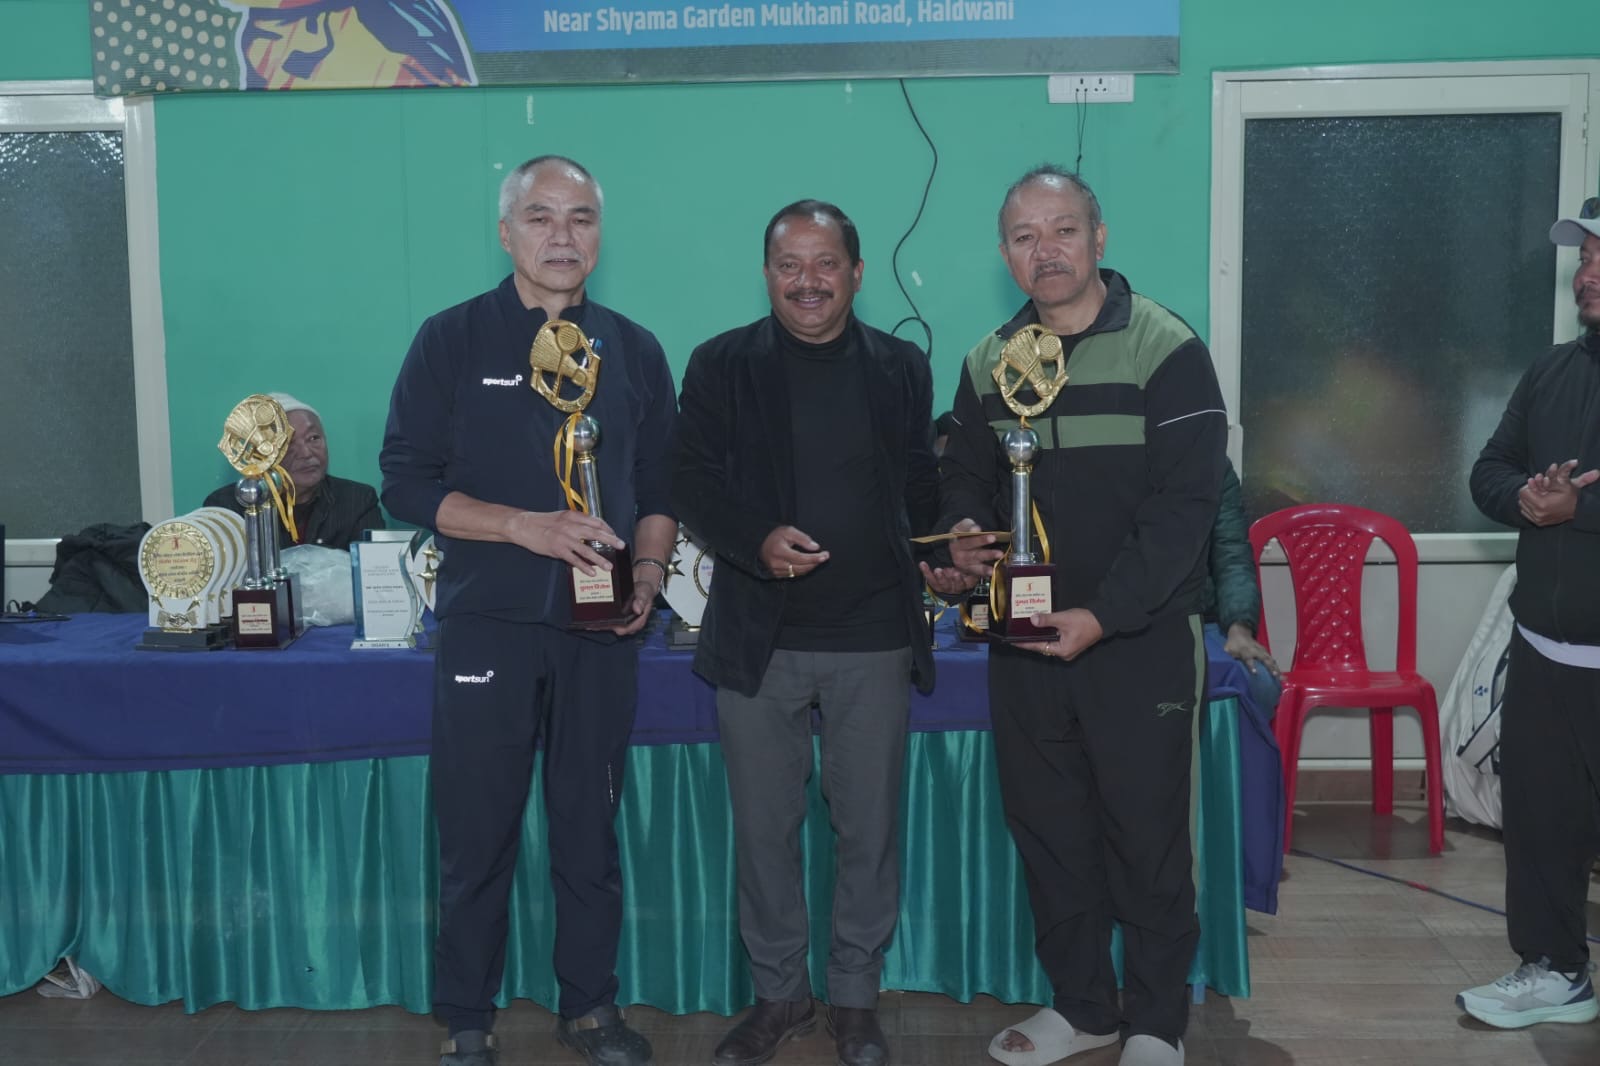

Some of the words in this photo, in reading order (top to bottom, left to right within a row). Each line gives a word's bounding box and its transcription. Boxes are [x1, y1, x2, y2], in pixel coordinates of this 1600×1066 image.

[543, 10, 592, 33] Near
[596, 7, 678, 35] Shyama
[683, 4, 755, 28] Garden
[760, 1, 849, 26] Mukhani
[855, 1, 912, 27] Road,
[917, 0, 1014, 22] Haldwani
